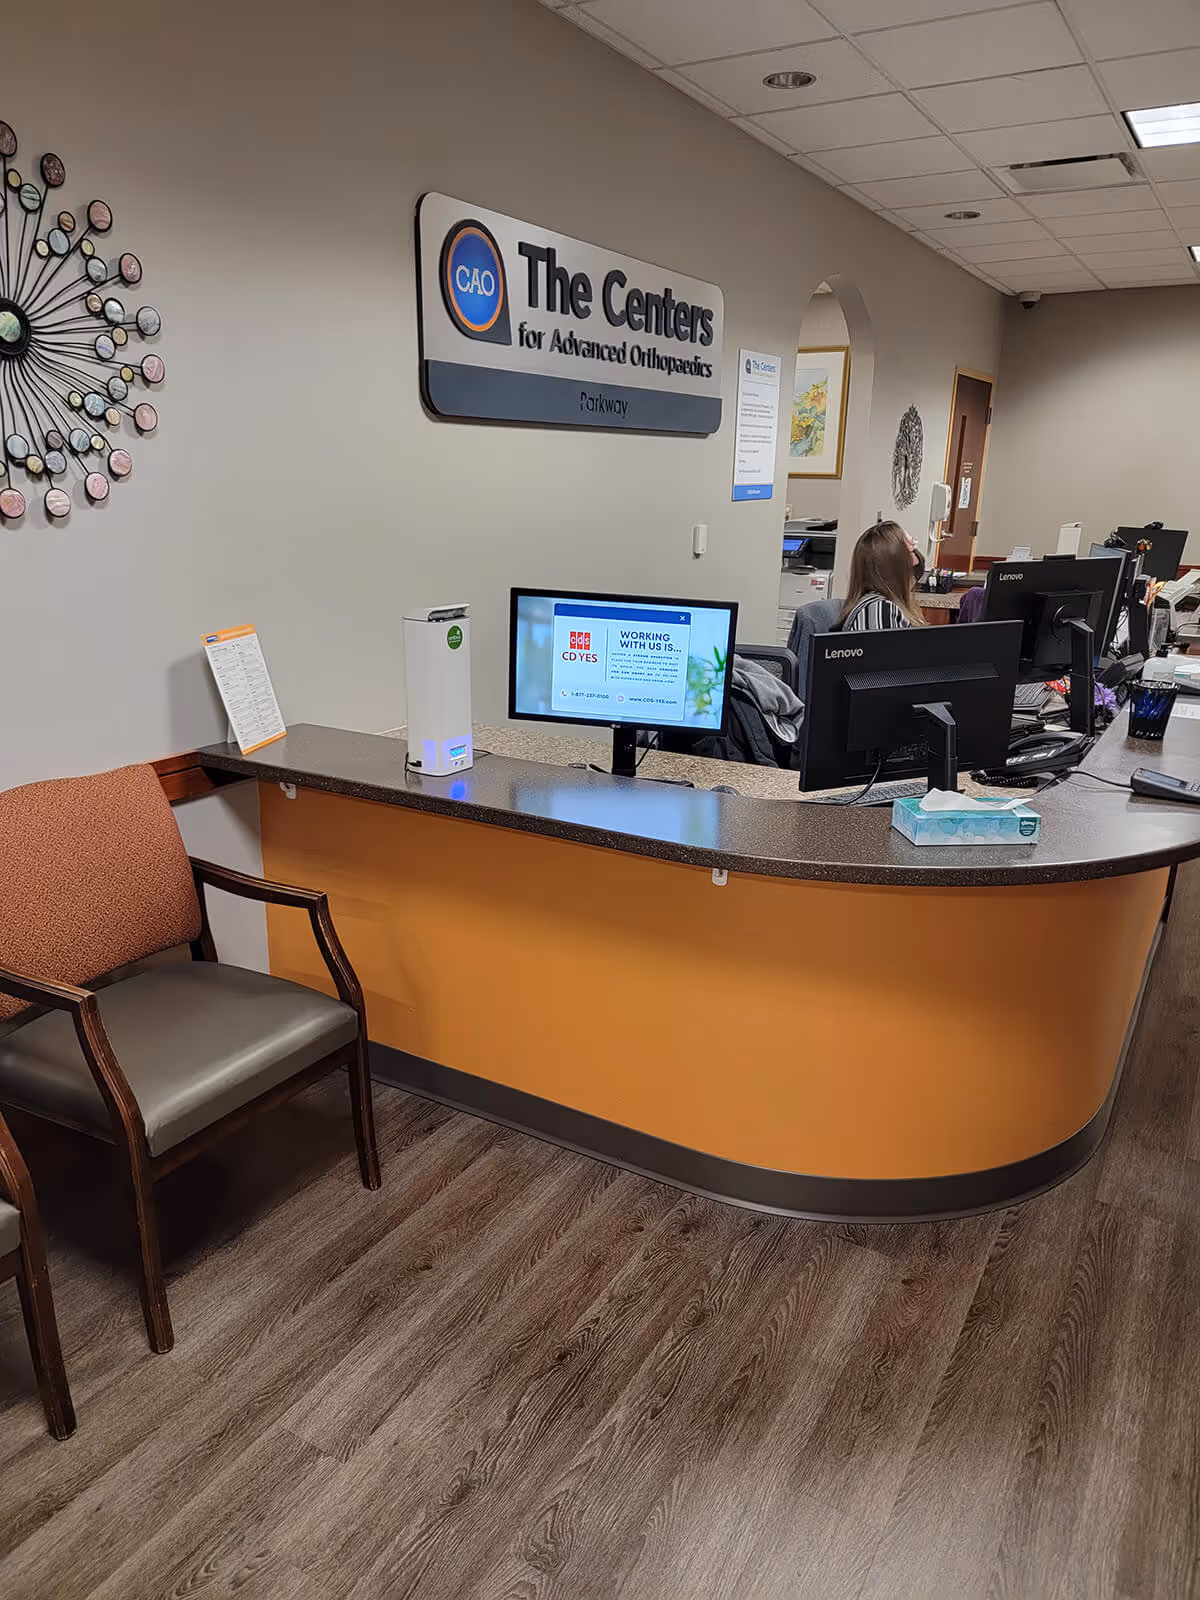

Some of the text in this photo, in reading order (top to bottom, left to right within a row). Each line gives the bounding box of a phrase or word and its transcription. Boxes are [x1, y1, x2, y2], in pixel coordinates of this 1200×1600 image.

[455, 264, 495, 296] CAO
[518, 241, 714, 346] The Centers
[518, 321, 713, 378] for Advanced Orthopaedics
[580, 391, 628, 419] Parkway
[999, 572, 1024, 581] Lenovo
[620, 630, 671, 642] WORKING
[620, 640, 682, 653] WITH US IS...
[562, 651, 577, 662] CD
[579, 653, 598, 664] YES
[825, 648, 864, 660] Lenovo
